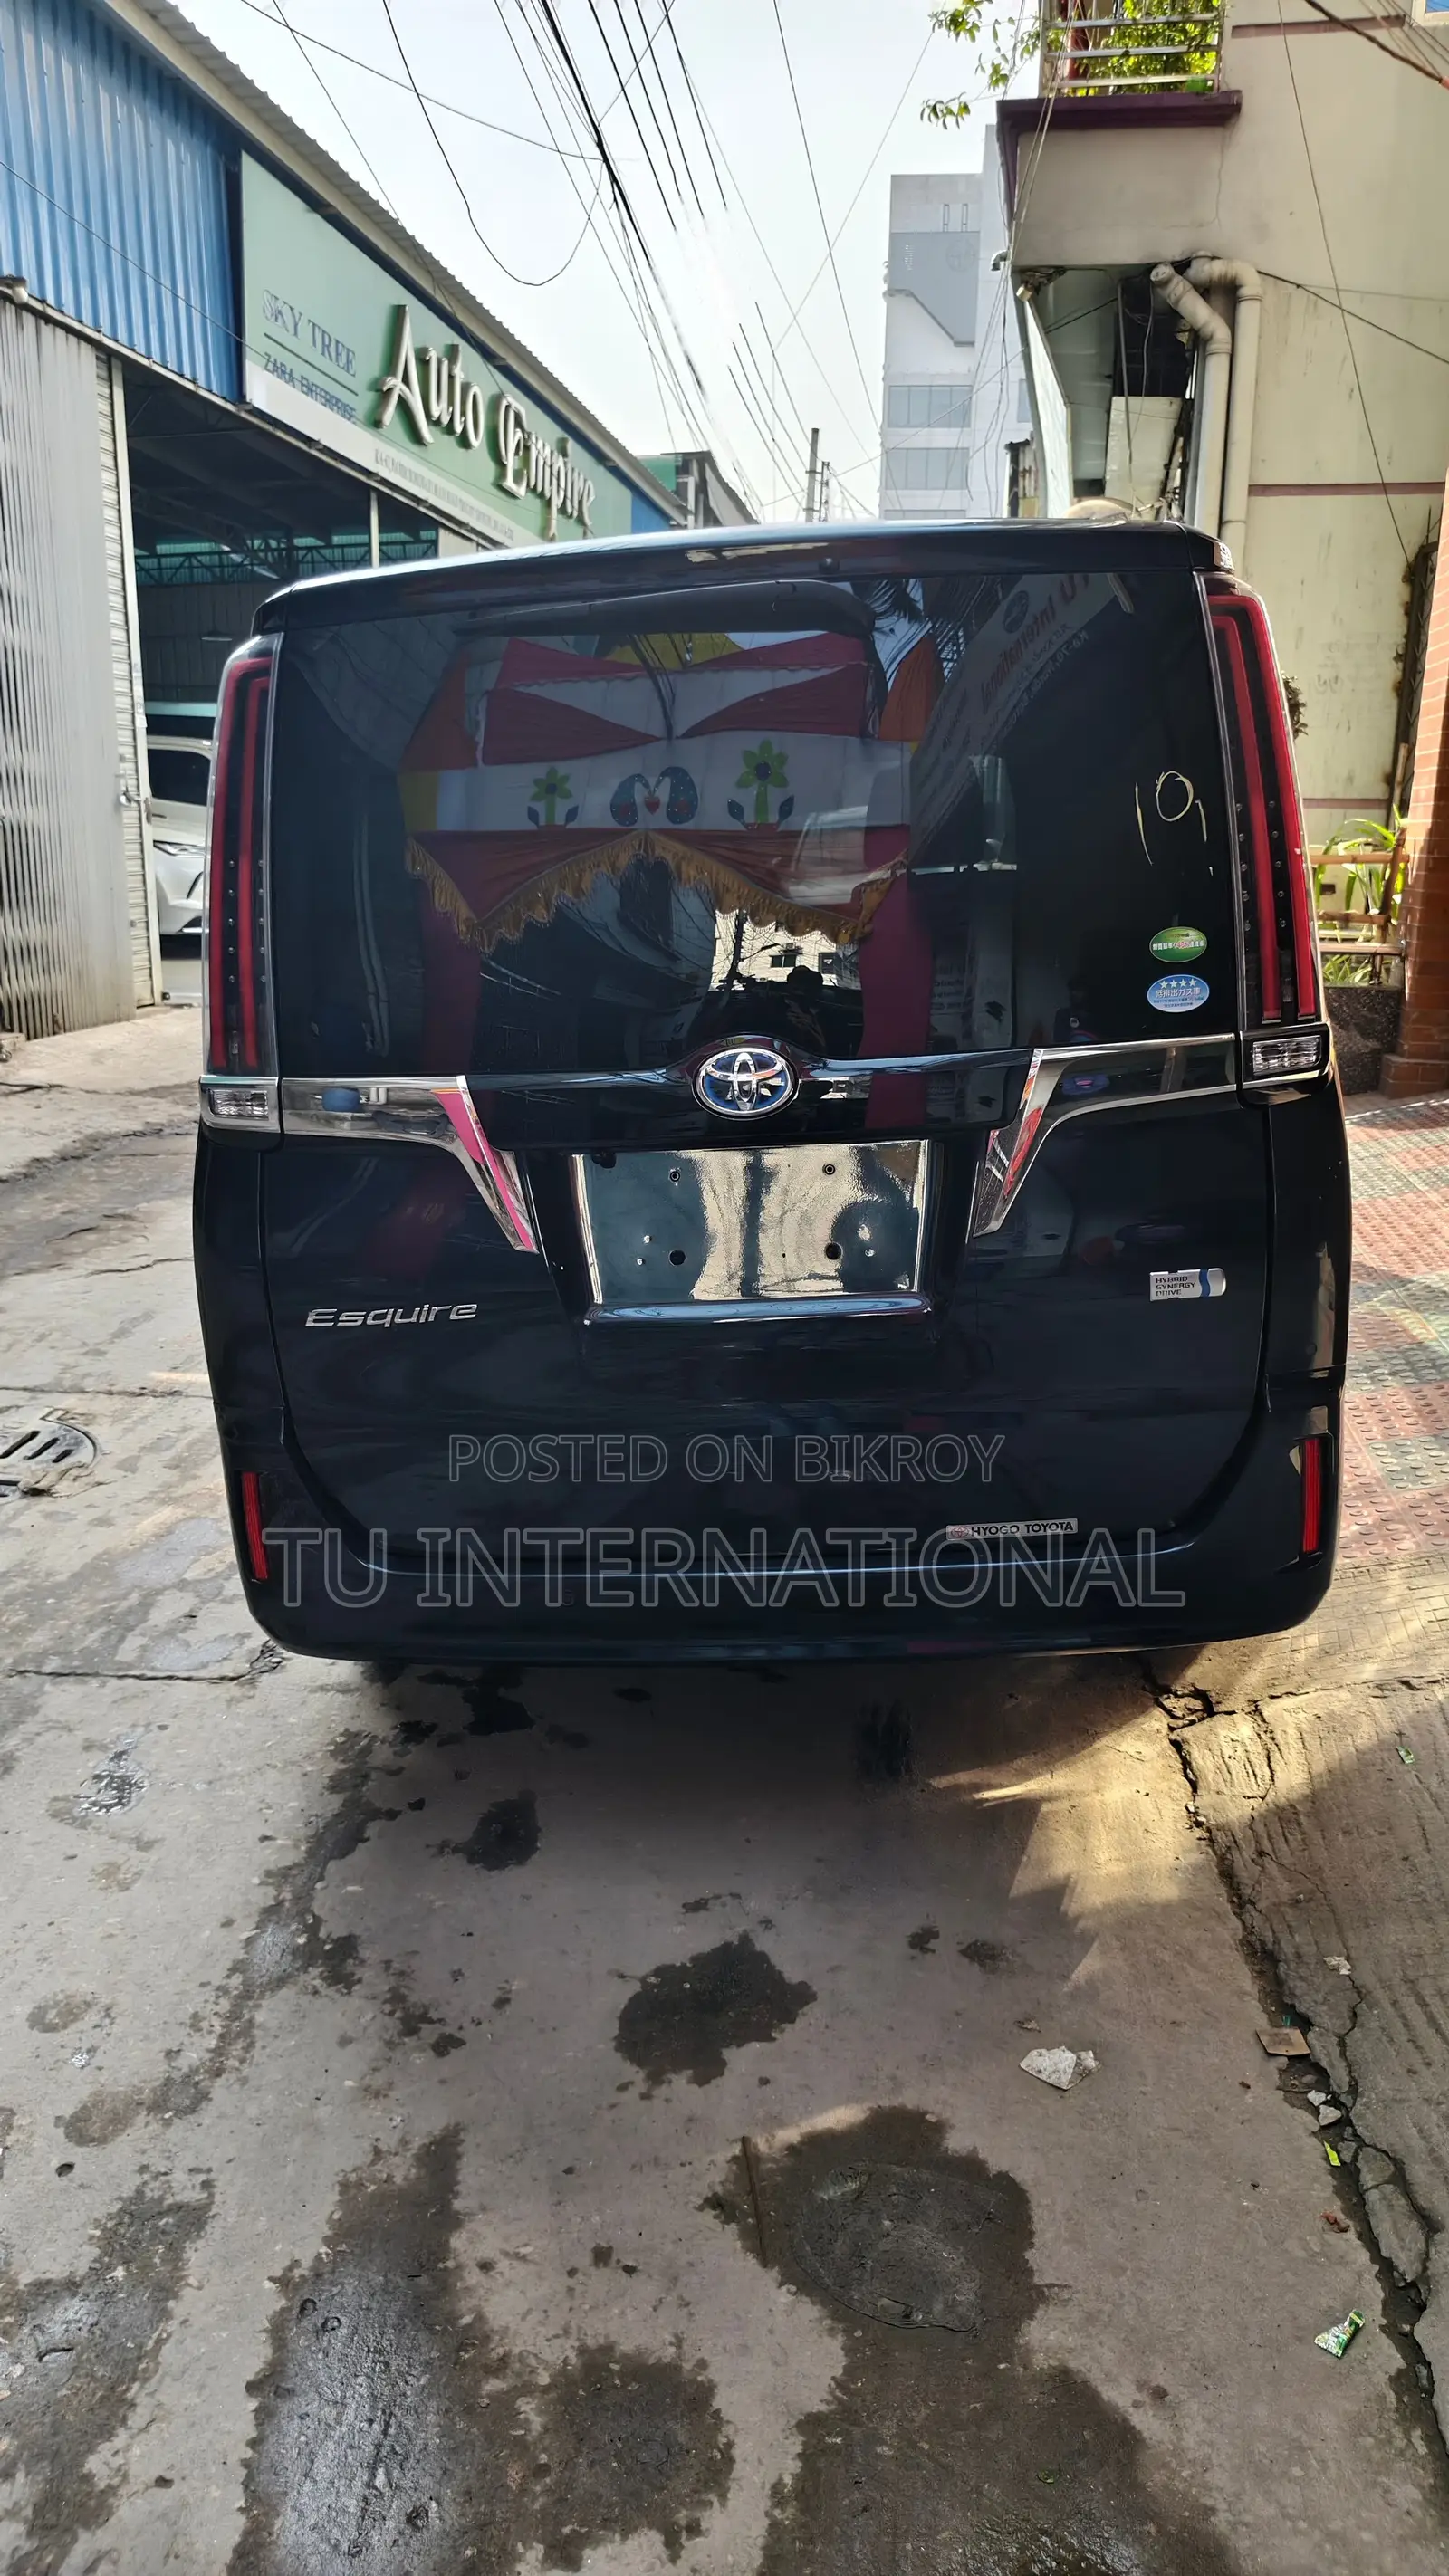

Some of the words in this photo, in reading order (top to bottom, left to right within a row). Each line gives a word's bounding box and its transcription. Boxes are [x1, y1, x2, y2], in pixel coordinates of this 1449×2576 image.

[262, 289, 303, 340] SKY
[307, 319, 357, 378] TREE
[264, 351, 297, 388] ZARA
[300, 374, 358, 425] ENTERPRISE
[376, 304, 485, 450] Auto
[496, 392, 596, 543] Empire
[1156, 1276, 1188, 1284] HYBRID
[1156, 1282, 1196, 1290] SYNERGY
[304, 1303, 478, 1328] Esquire
[971, 1524, 1020, 1537] HYOGO
[1024, 1521, 1074, 1534] TOYOTA
